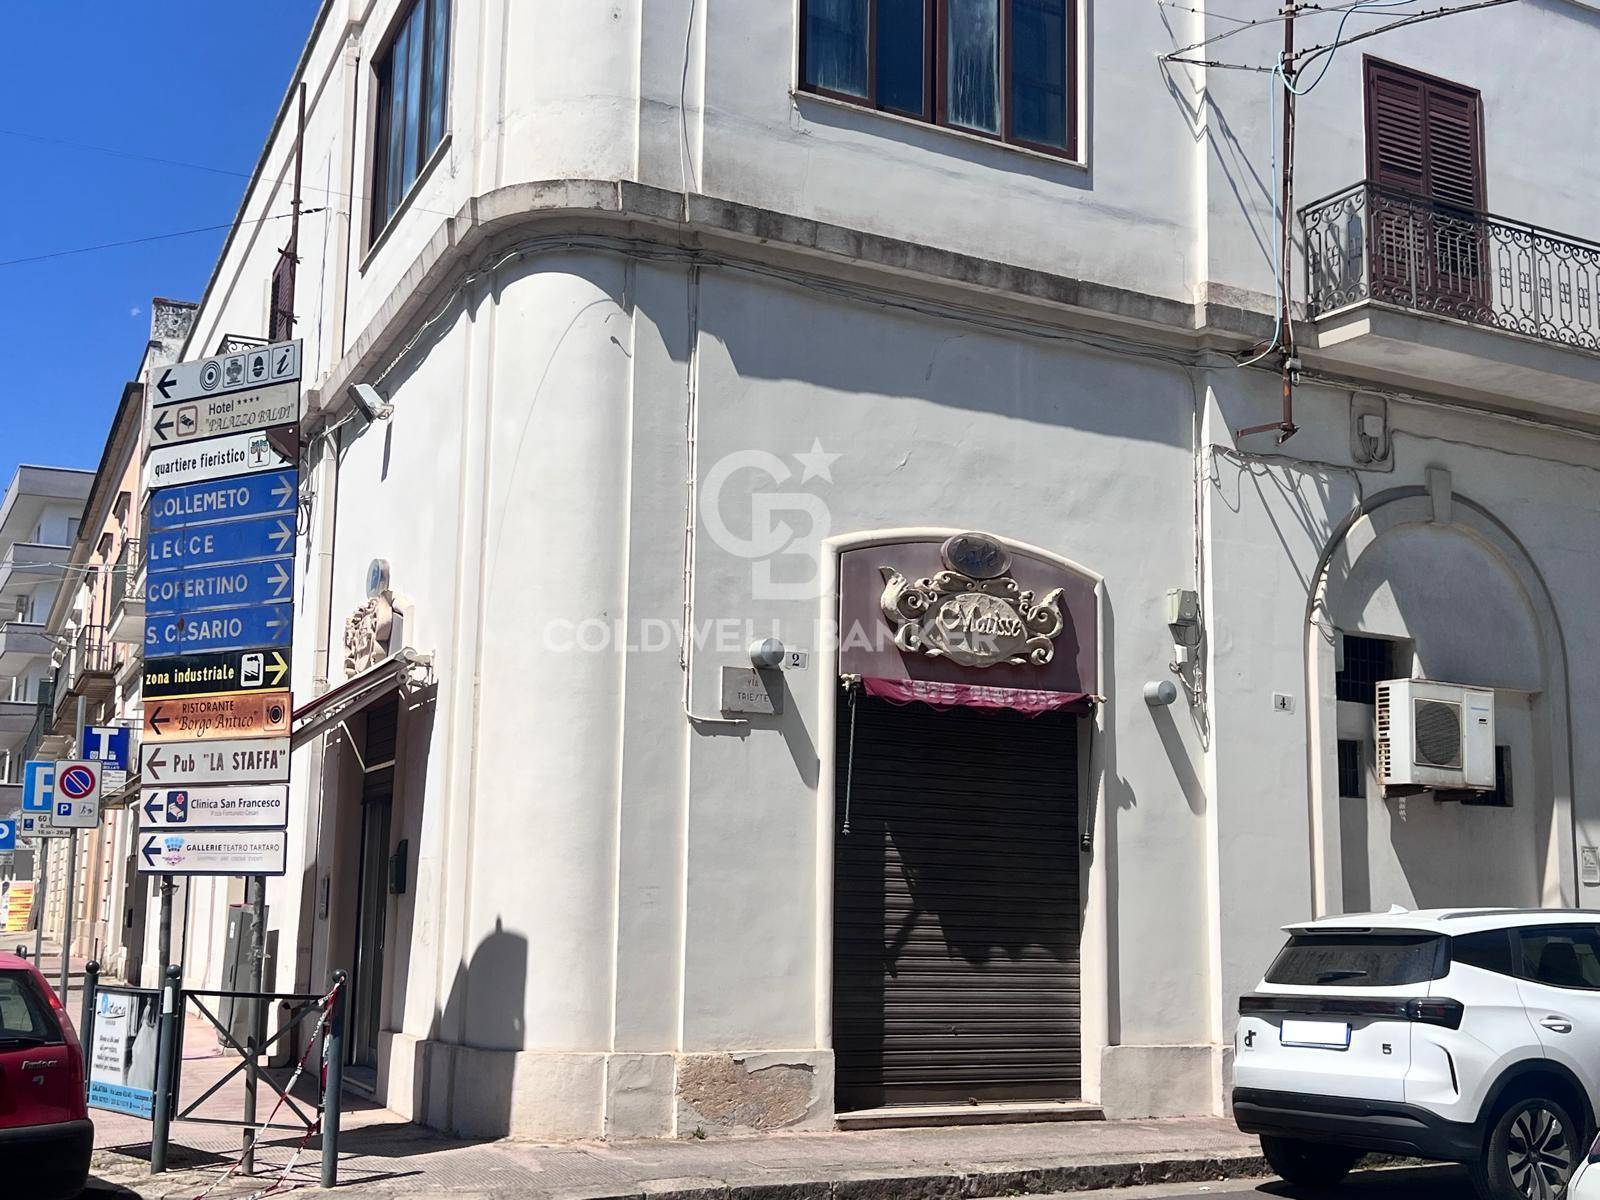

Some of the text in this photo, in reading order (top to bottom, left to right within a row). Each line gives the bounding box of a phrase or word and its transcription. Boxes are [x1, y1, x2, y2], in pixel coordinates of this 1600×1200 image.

[208, 400, 234, 416] Hotel
[154, 448, 245, 477] quartiere fieristico
[150, 535, 214, 560] LECCE
[940, 602, 1022, 637] Matisse
[146, 626, 160, 645] S.
[792, 653, 800, 667] 2
[145, 664, 235, 685] zona industriale
[182, 700, 235, 713] RISTORANTE
[92, 728, 119, 760] T
[173, 749, 286, 772] Pub "LA STAFFA"
[60, 804, 69, 815] P
[190, 797, 281, 809] Clinica San Francesco
[186, 843, 280, 852] GALLERIE TEATRO TARTARO
[1382, 1043, 1393, 1055] 5
